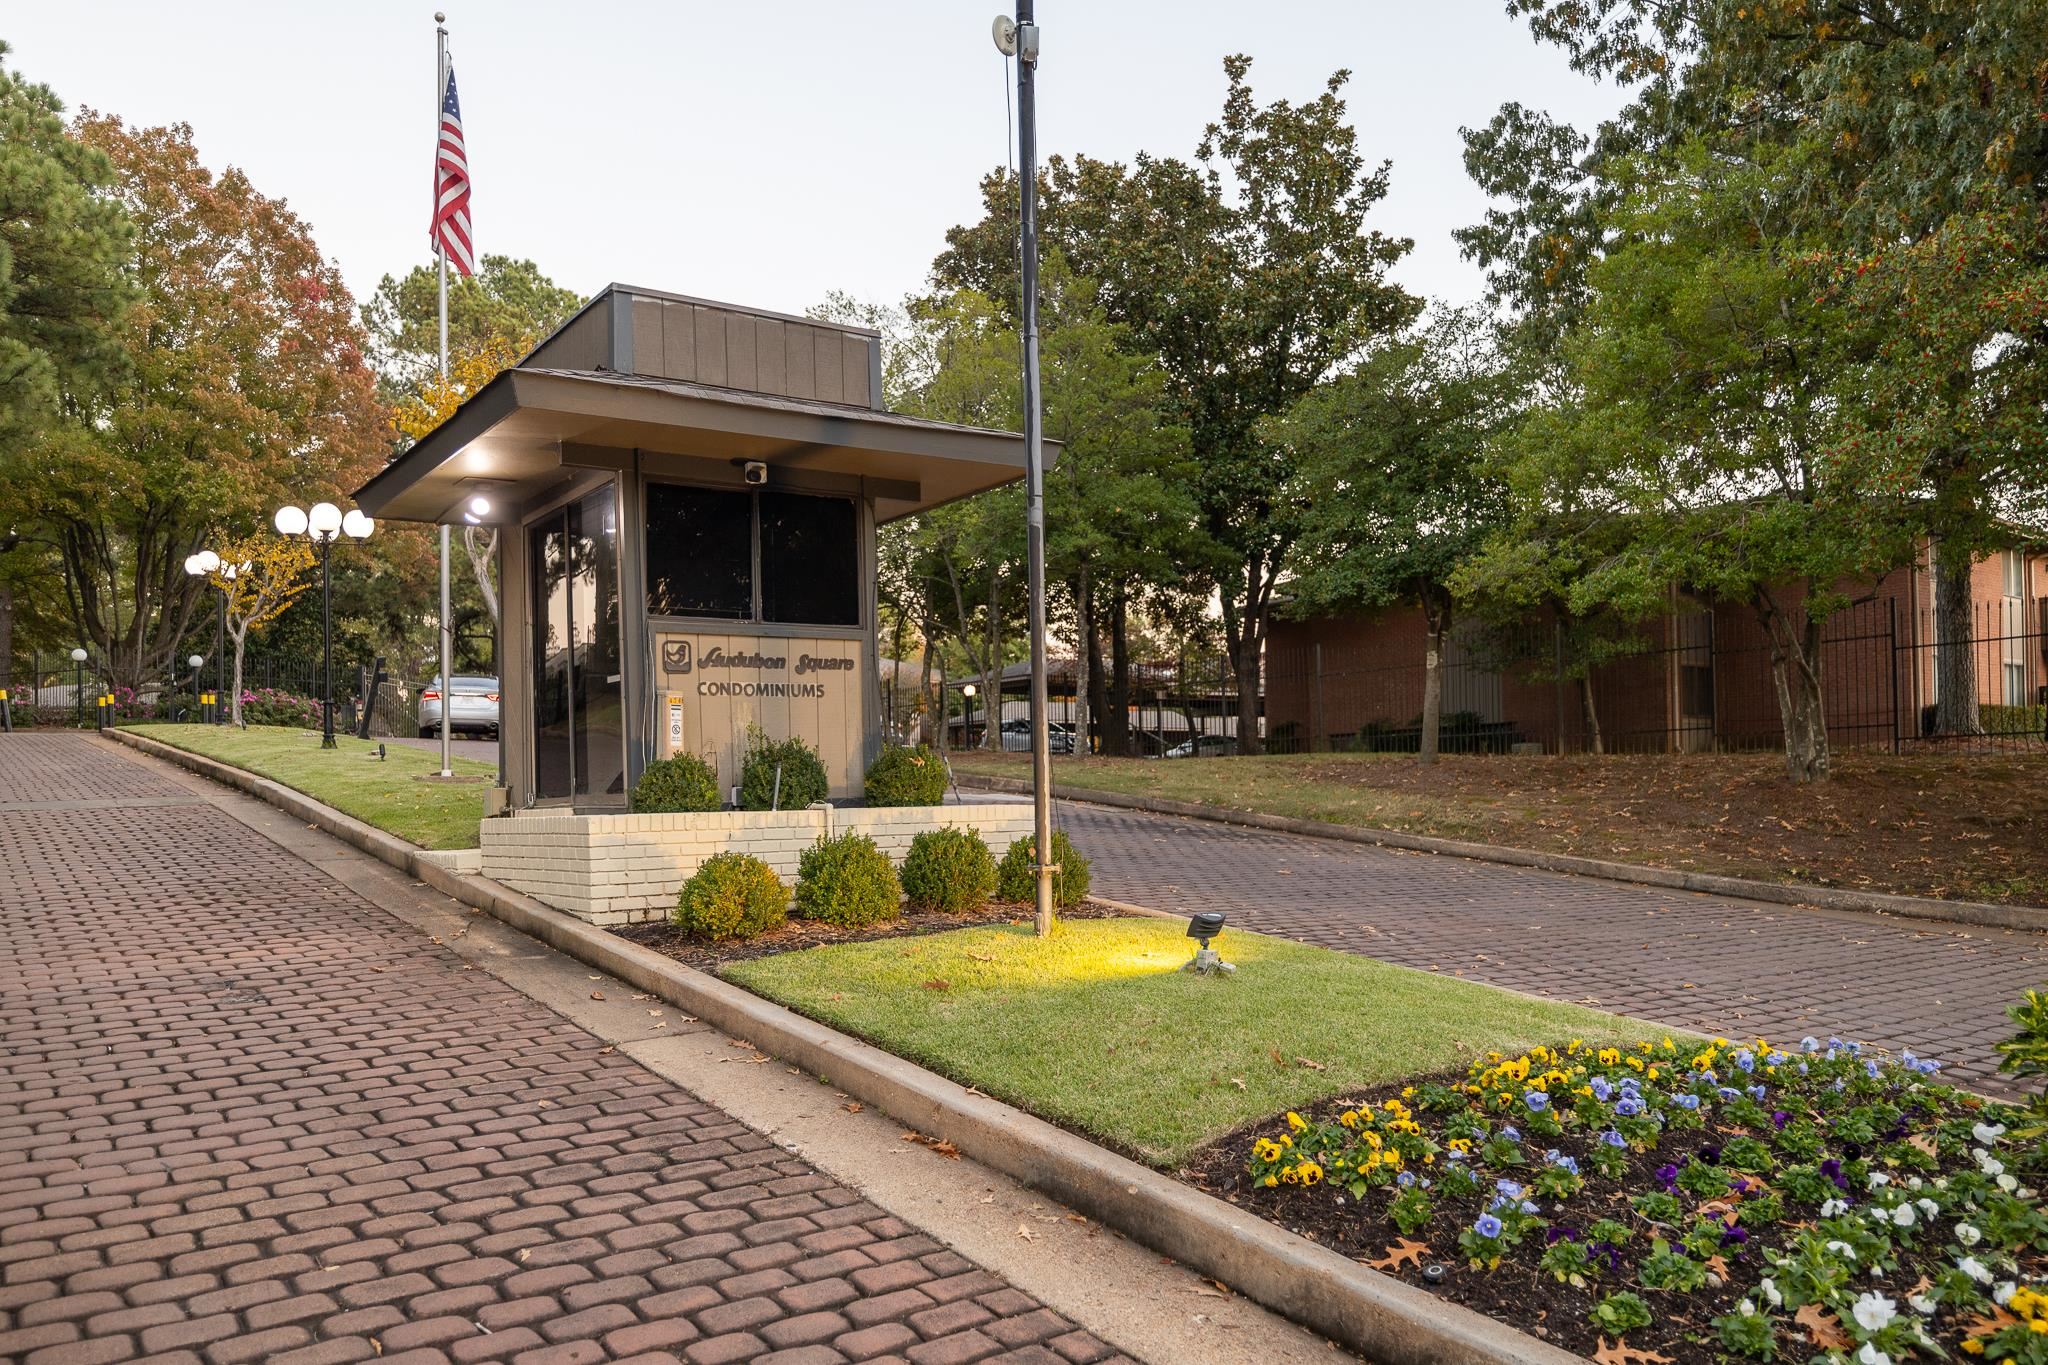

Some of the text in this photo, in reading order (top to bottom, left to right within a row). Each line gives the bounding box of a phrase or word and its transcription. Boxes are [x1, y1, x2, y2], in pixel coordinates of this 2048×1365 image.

[697, 646, 855, 675] Audubon Square
[697, 681, 825, 698] CONDOMINIUMS
